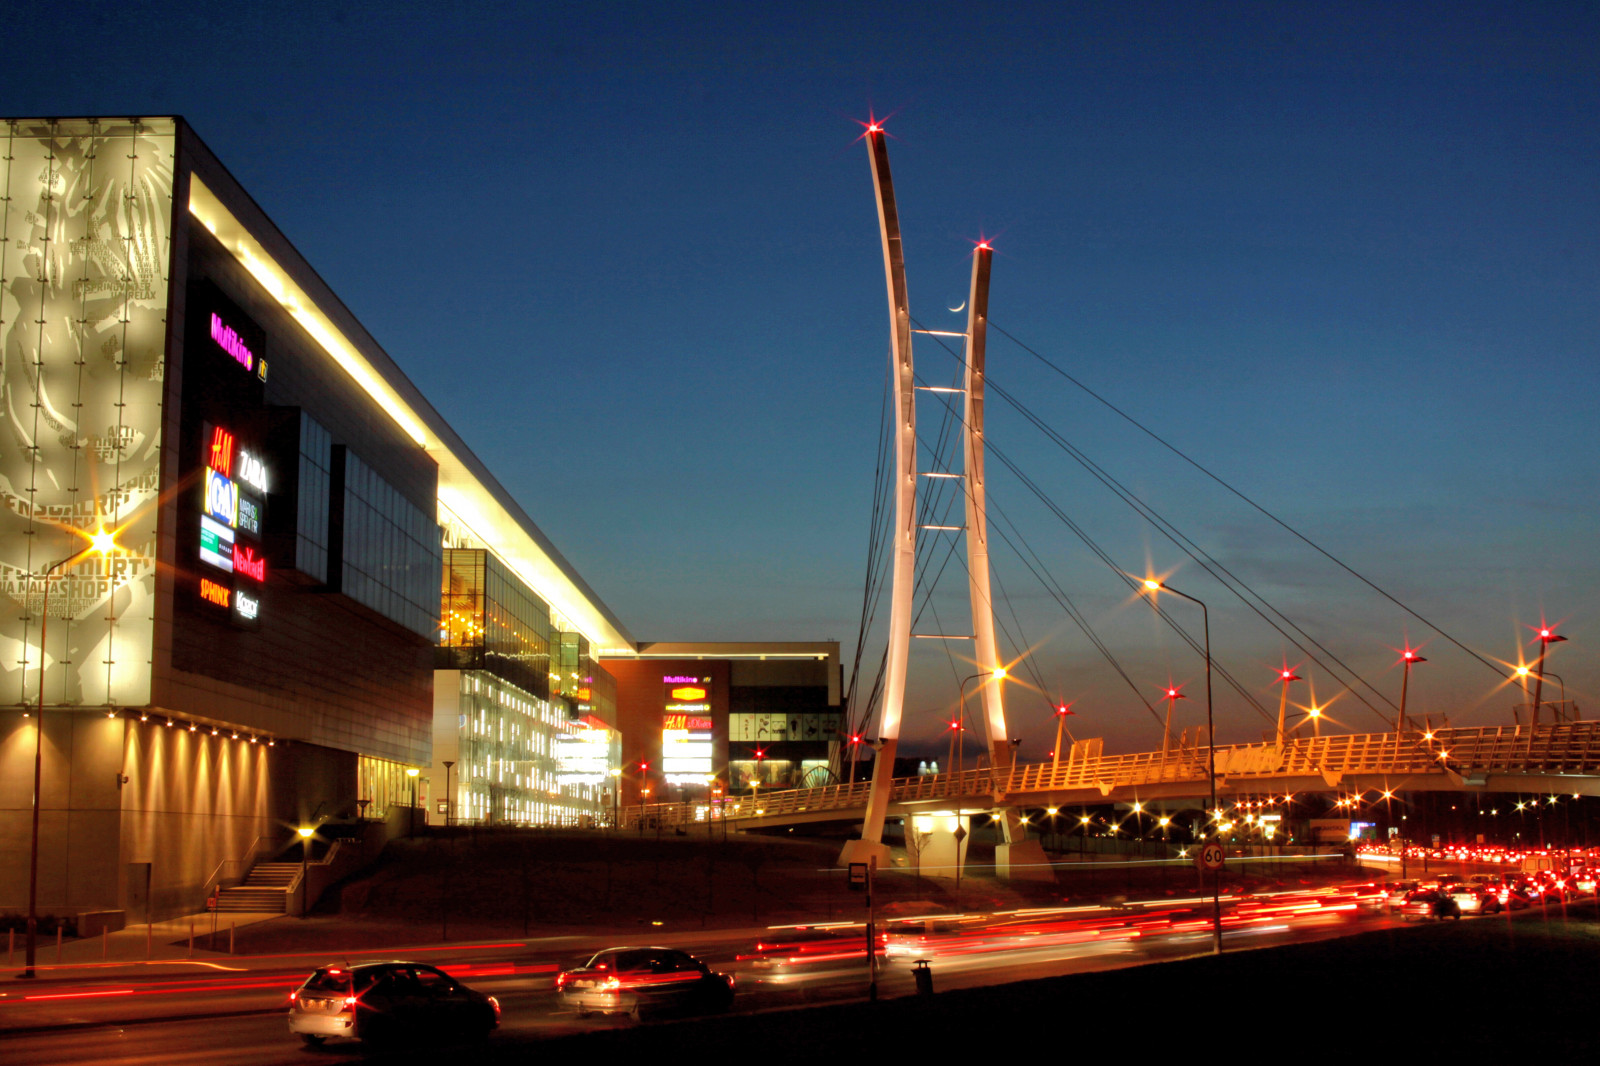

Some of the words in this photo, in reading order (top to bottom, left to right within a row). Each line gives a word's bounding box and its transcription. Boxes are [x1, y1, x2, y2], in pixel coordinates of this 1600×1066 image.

[128, 291, 156, 300] RELAX
[211, 312, 253, 372] Multikino
[211, 426, 233, 478] H&M
[239, 450, 268, 494] ZARA
[212, 476, 233, 520] C&A
[200, 578, 229, 608] SPHINX
[663, 676, 698, 684] Multikino
[664, 715, 687, 729] H&M
[1206, 849, 1222, 862] 60
